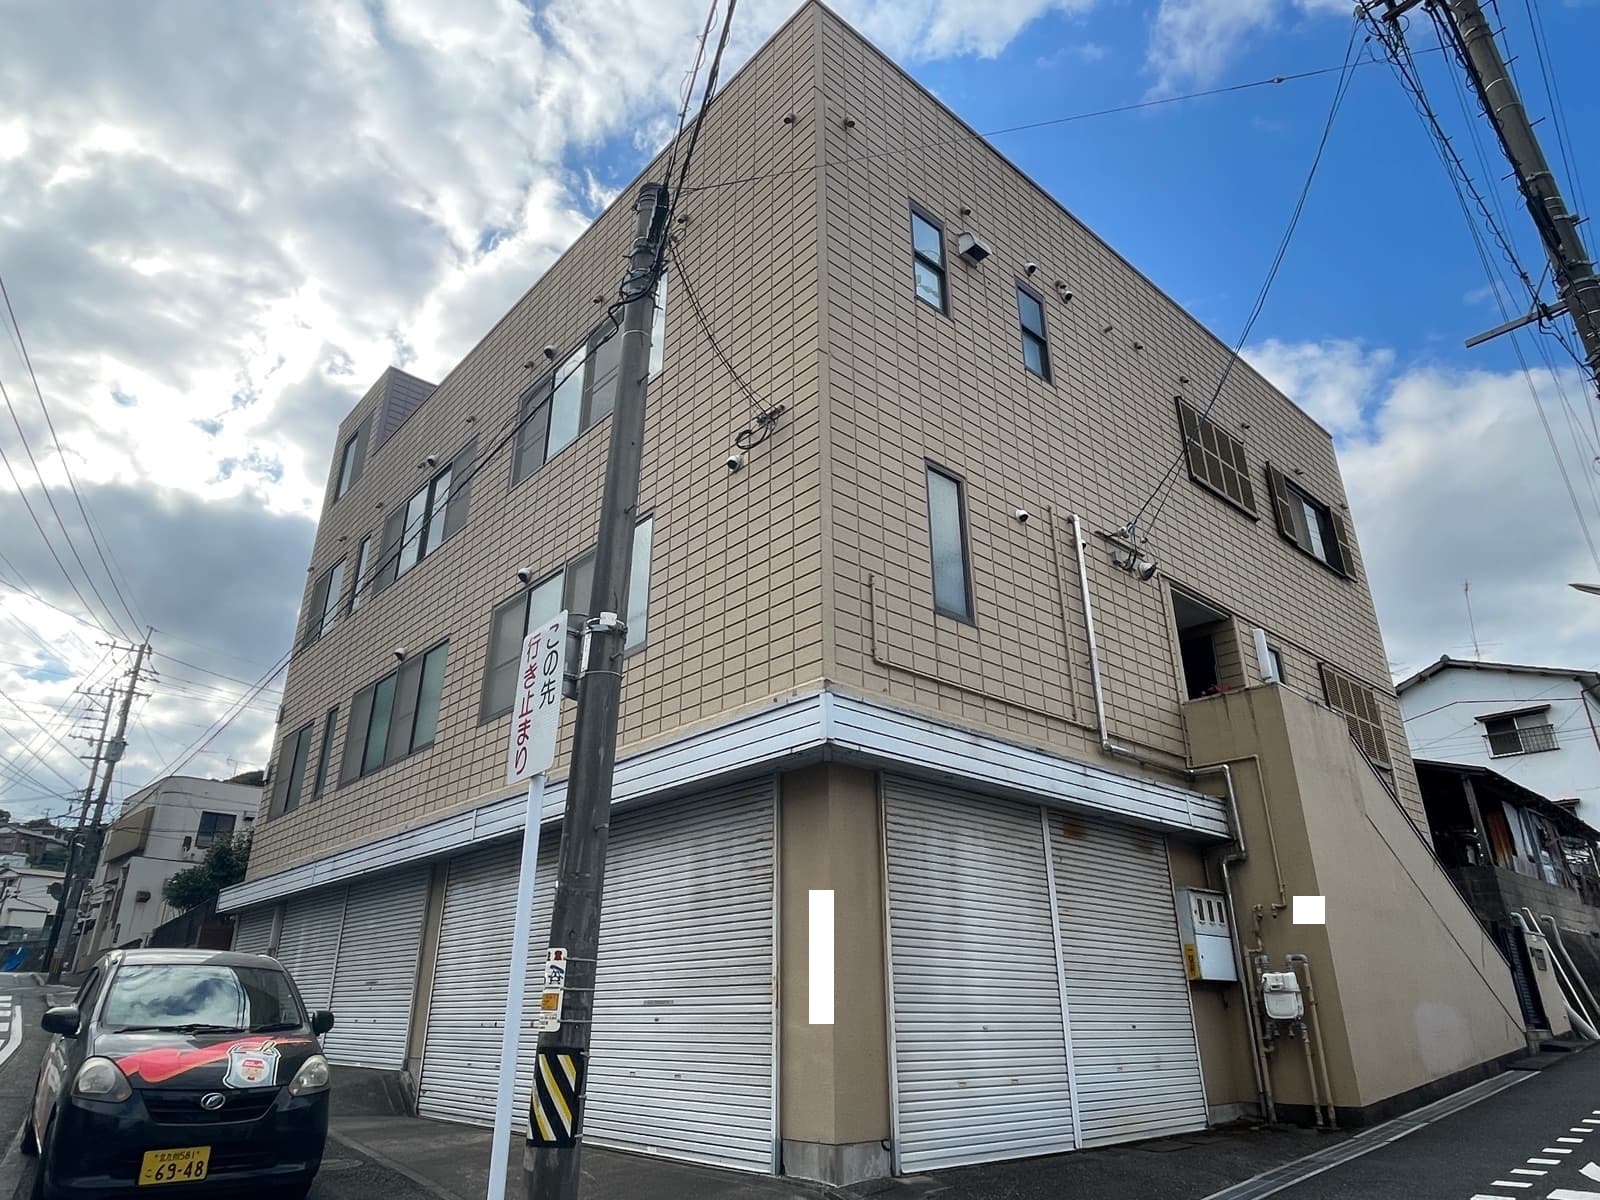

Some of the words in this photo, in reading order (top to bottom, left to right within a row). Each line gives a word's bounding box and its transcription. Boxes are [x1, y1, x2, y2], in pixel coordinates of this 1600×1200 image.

[515, 633, 542, 775] 行き止まり
[539, 623, 560, 710] この先
[155, 1161, 204, 1181] 69-48
